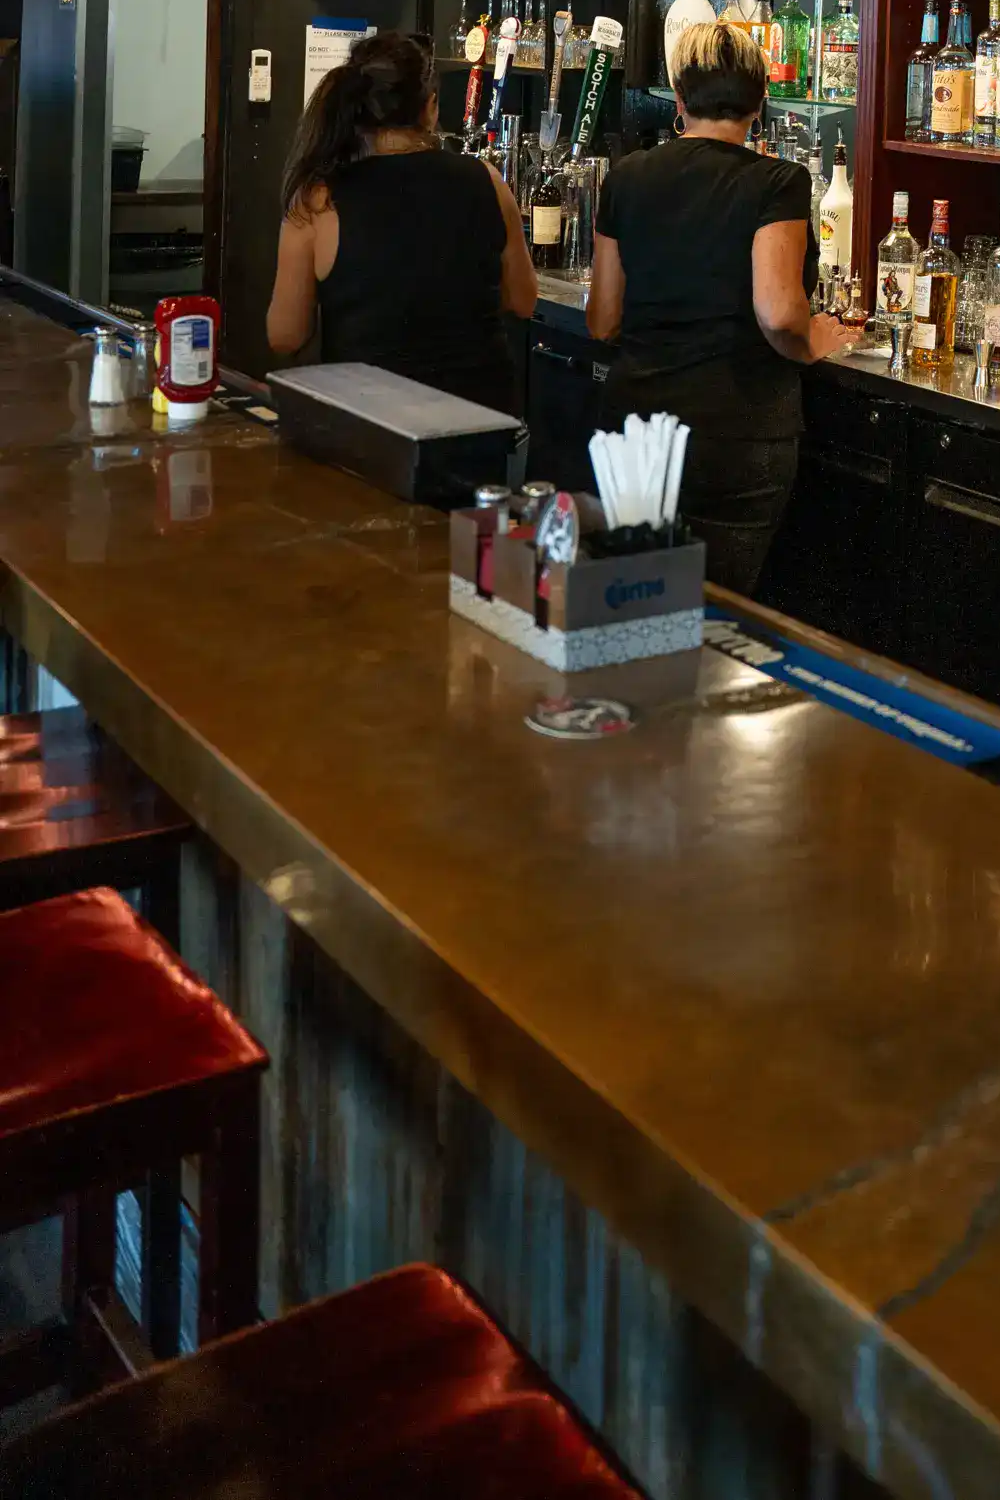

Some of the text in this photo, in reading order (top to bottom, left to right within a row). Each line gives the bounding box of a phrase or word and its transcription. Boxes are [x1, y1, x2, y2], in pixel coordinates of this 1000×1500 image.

[577, 53, 607, 143] SCOTCH ALE
[933, 75, 956, 85] Tito's
